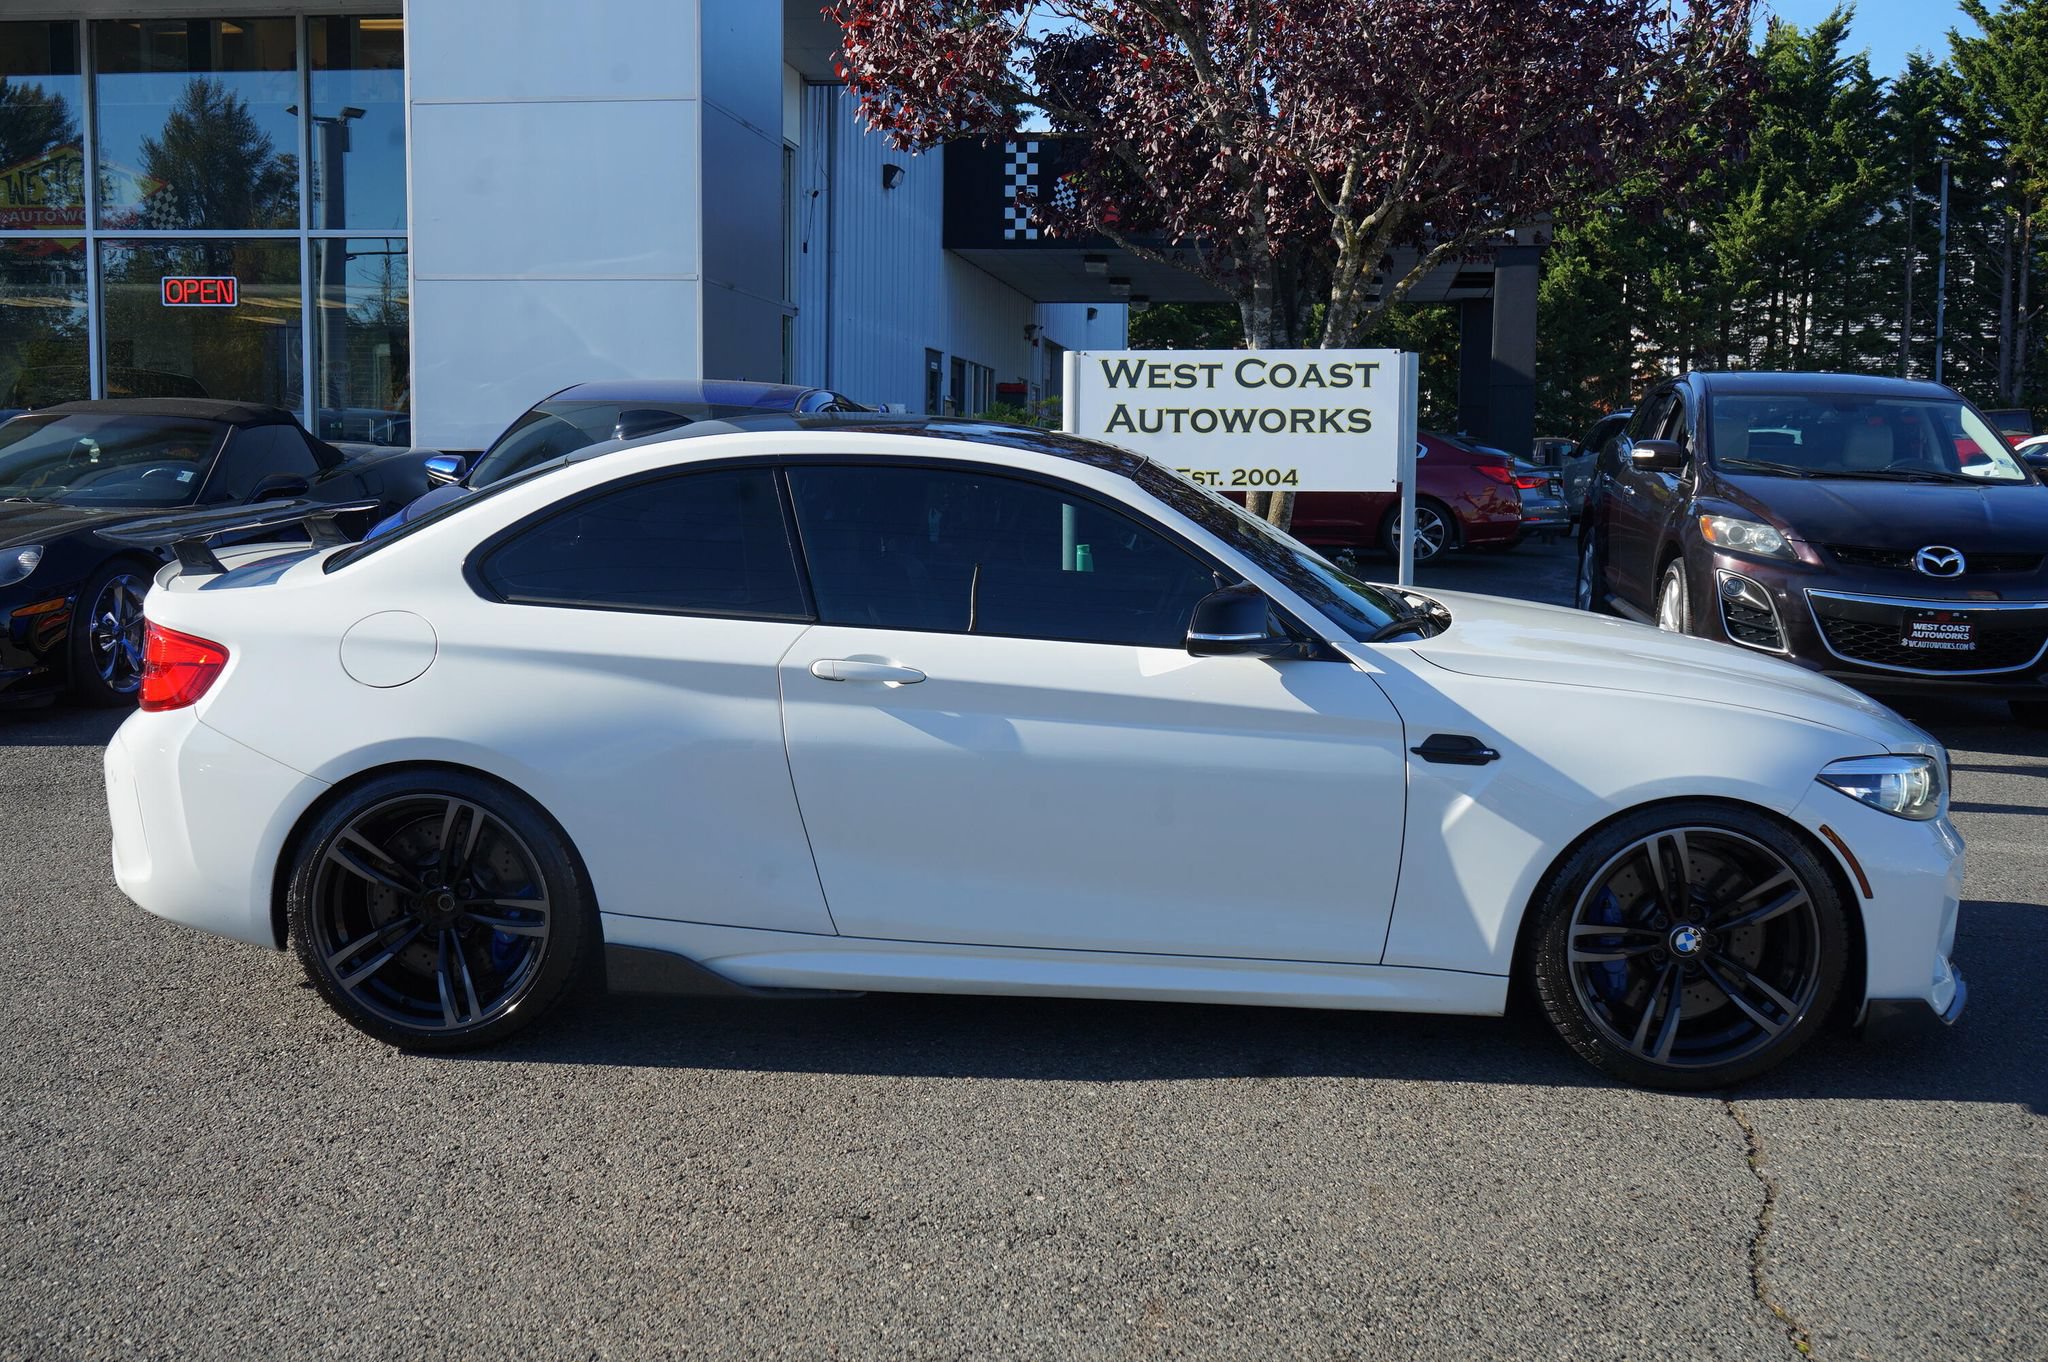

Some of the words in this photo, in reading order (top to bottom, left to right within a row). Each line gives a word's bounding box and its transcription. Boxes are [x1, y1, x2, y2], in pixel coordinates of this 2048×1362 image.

[9, 210, 57, 223] AUTO
[165, 279, 234, 303] OPEN
[1099, 359, 1223, 389] WEST
[1234, 358, 1380, 389] COAST
[1104, 403, 1372, 434] AUTOWORKS
[1231, 468, 1299, 487] 2004
[1911, 630, 1970, 640] AUTOWORKS
[1912, 622, 1939, 630] WEST
[1940, 624, 1971, 632] COAST
